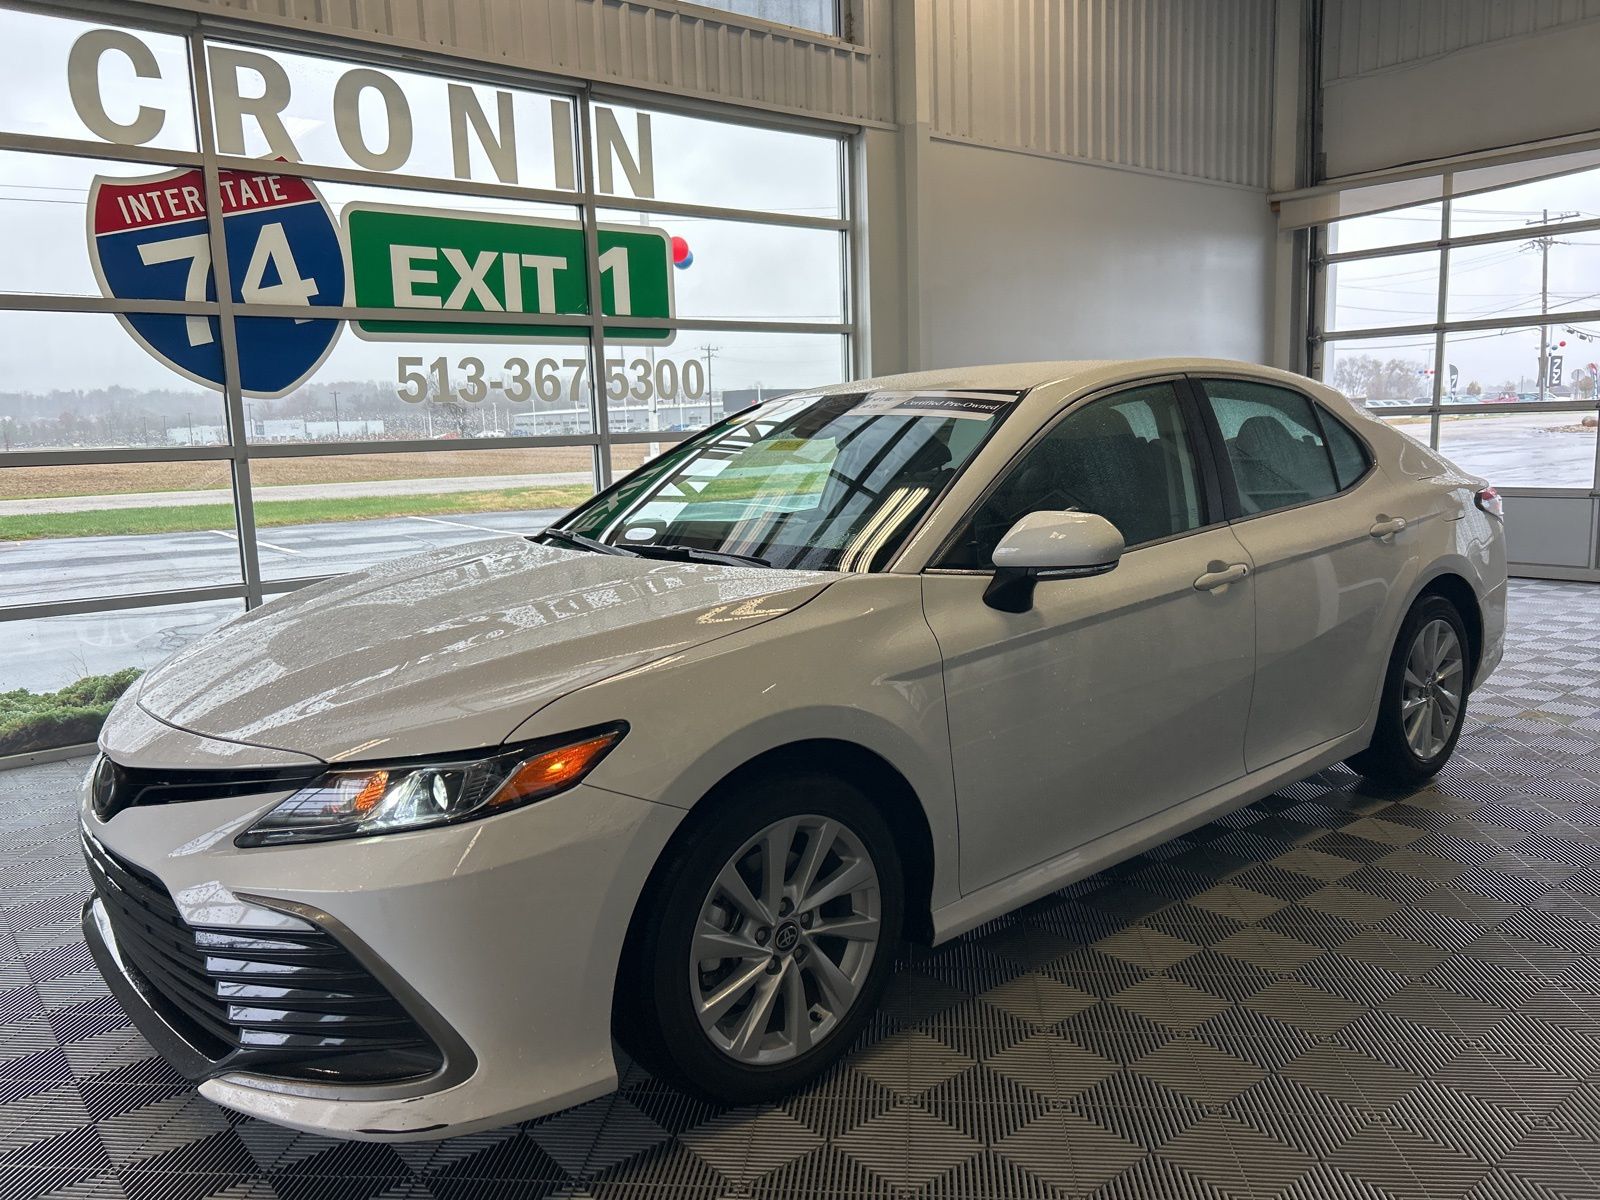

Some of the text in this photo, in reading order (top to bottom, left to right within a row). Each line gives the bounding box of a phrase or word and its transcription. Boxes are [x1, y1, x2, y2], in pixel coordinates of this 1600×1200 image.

[67, 28, 655, 199] CRONIN
[117, 174, 288, 225] INTERTATE
[136, 222, 320, 347] 74
[389, 244, 632, 316] EXIT 1
[903, 399, 1000, 410] Certified Pre-Owned
